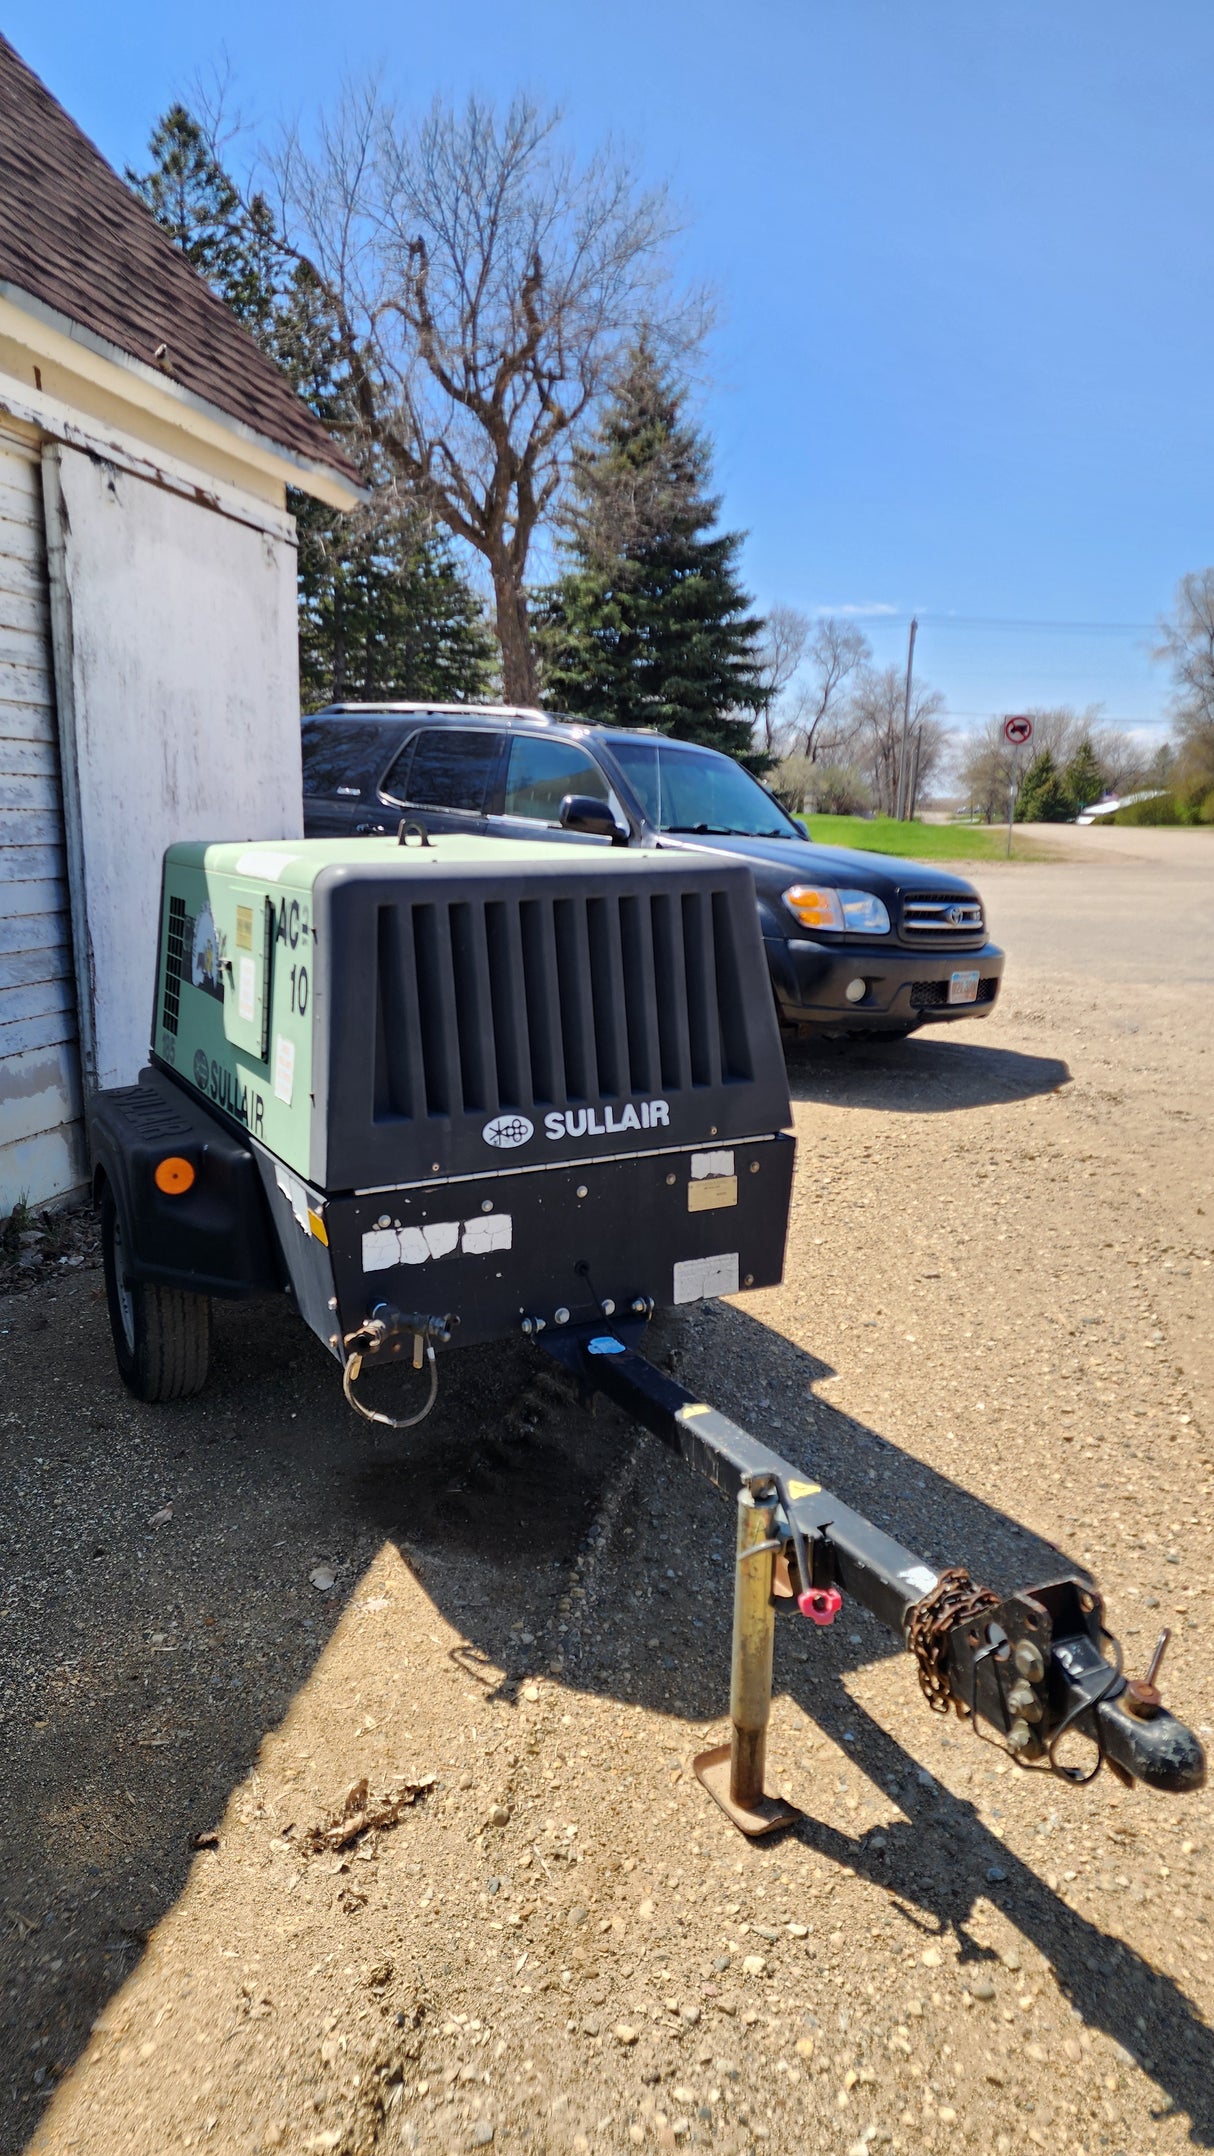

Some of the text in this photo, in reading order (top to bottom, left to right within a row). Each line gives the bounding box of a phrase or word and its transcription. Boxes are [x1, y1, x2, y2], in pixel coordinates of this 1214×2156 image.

[291, 964, 308, 1016] 10
[210, 1059, 264, 1139] SULLAIR
[544, 1100, 670, 1140] SULLAIR
